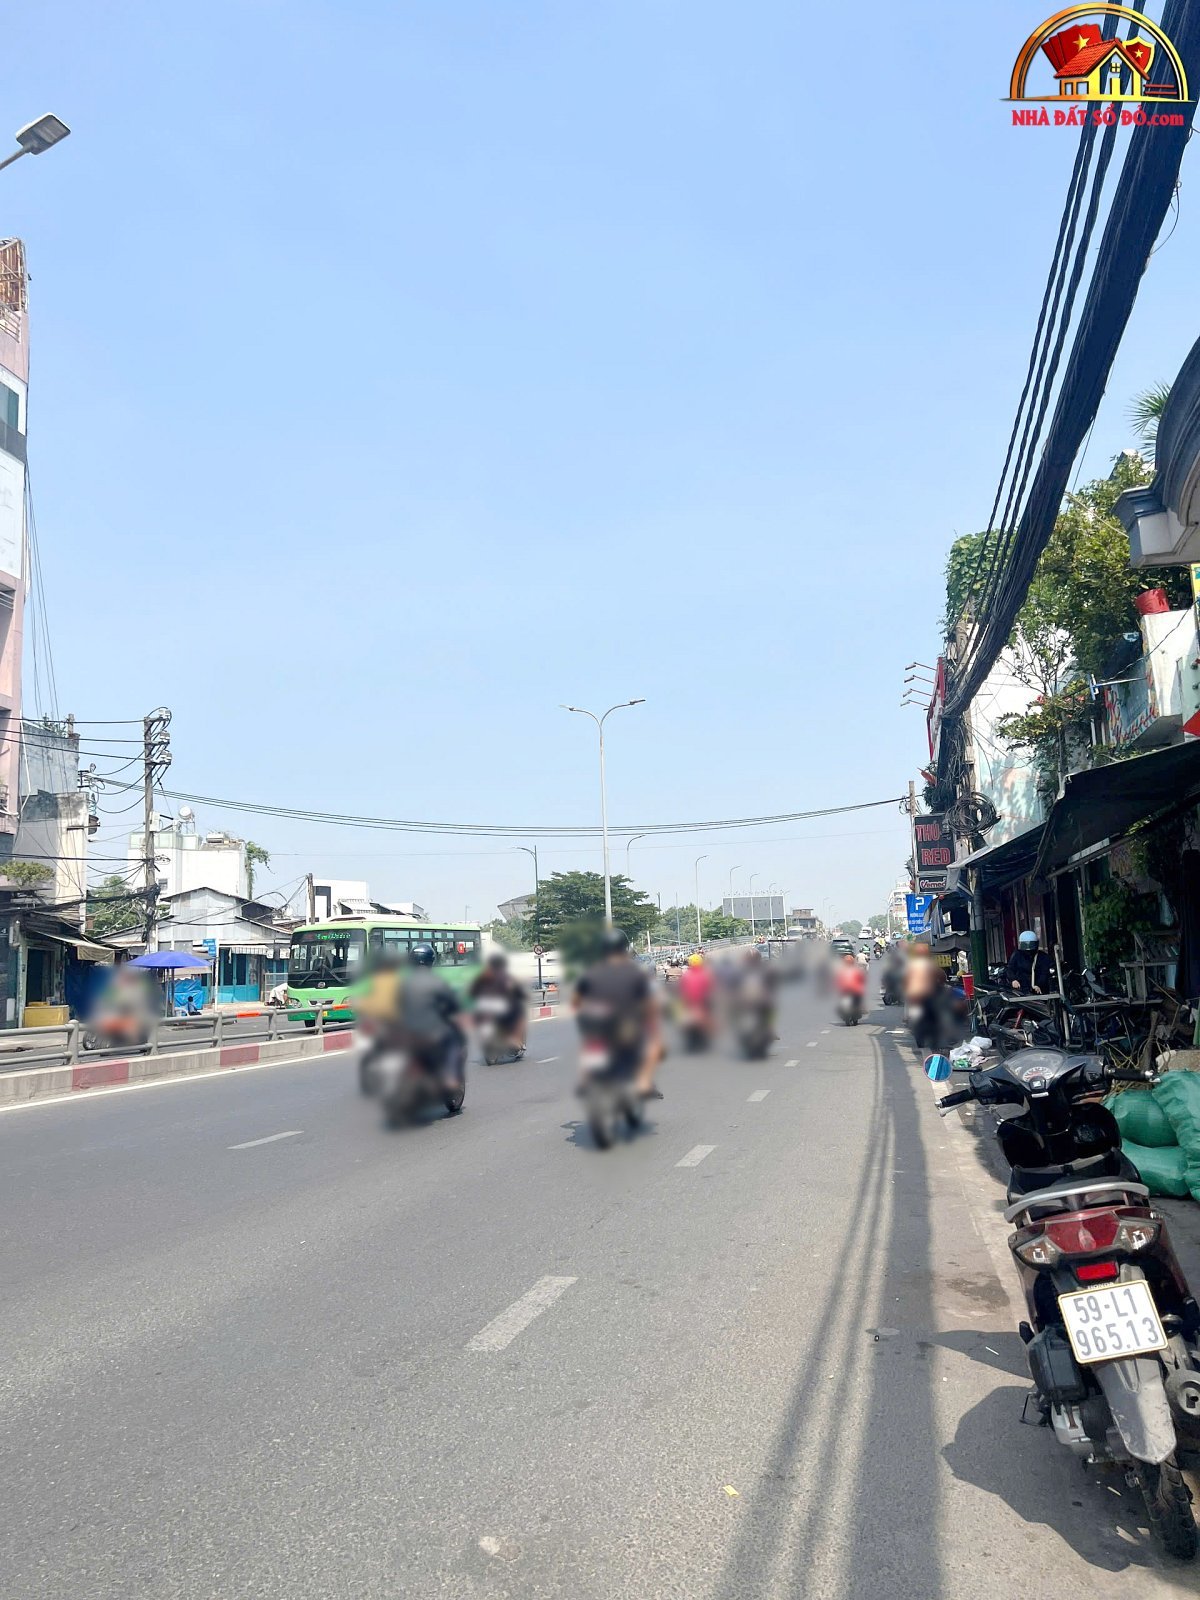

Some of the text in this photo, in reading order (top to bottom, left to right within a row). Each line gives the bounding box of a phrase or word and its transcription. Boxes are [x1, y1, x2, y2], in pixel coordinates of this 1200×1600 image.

[921, 847, 951, 866] RED
[1073, 1288, 1138, 1324] 59-L1
[1075, 1317, 1159, 1356] 965.13
